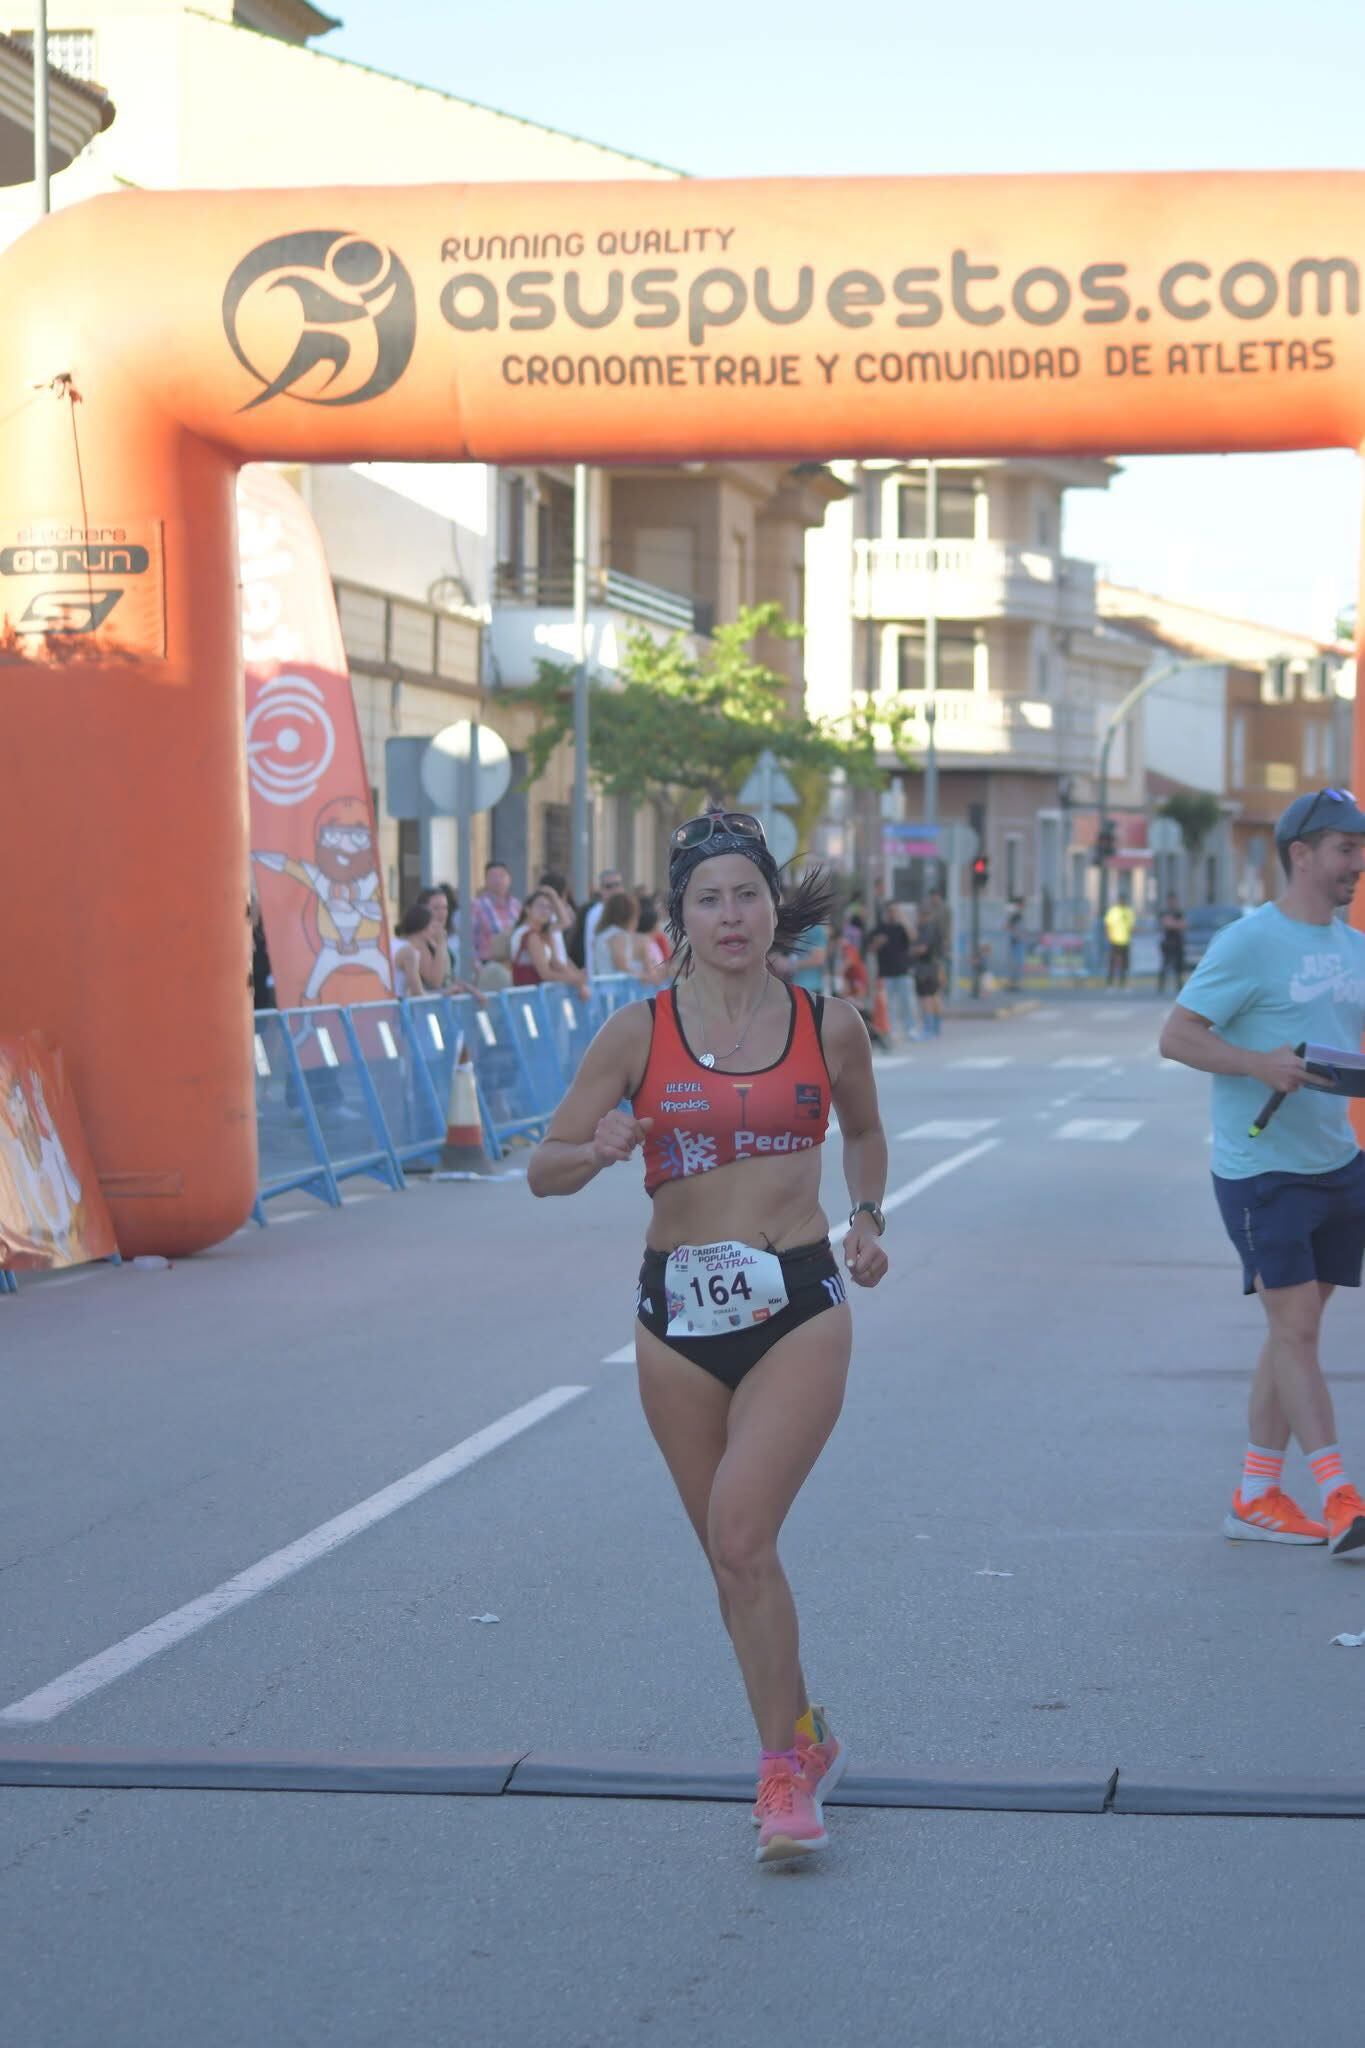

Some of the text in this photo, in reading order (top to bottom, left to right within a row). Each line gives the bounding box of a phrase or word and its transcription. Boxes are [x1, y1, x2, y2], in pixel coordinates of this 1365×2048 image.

[441, 228, 735, 262] RUNNING QUALITY
[440, 248, 1360, 346] asuspuestos.com
[502, 339, 1335, 386] CRONOMETRAJE Y COMUNIDAD DE ATLETAS
[734, 1130, 813, 1151] Pedro
[692, 1244, 733, 1257] CARRERA
[698, 1250, 742, 1263] POPULAR
[706, 1255, 757, 1272] CATRAL
[689, 1271, 753, 1307] 164
